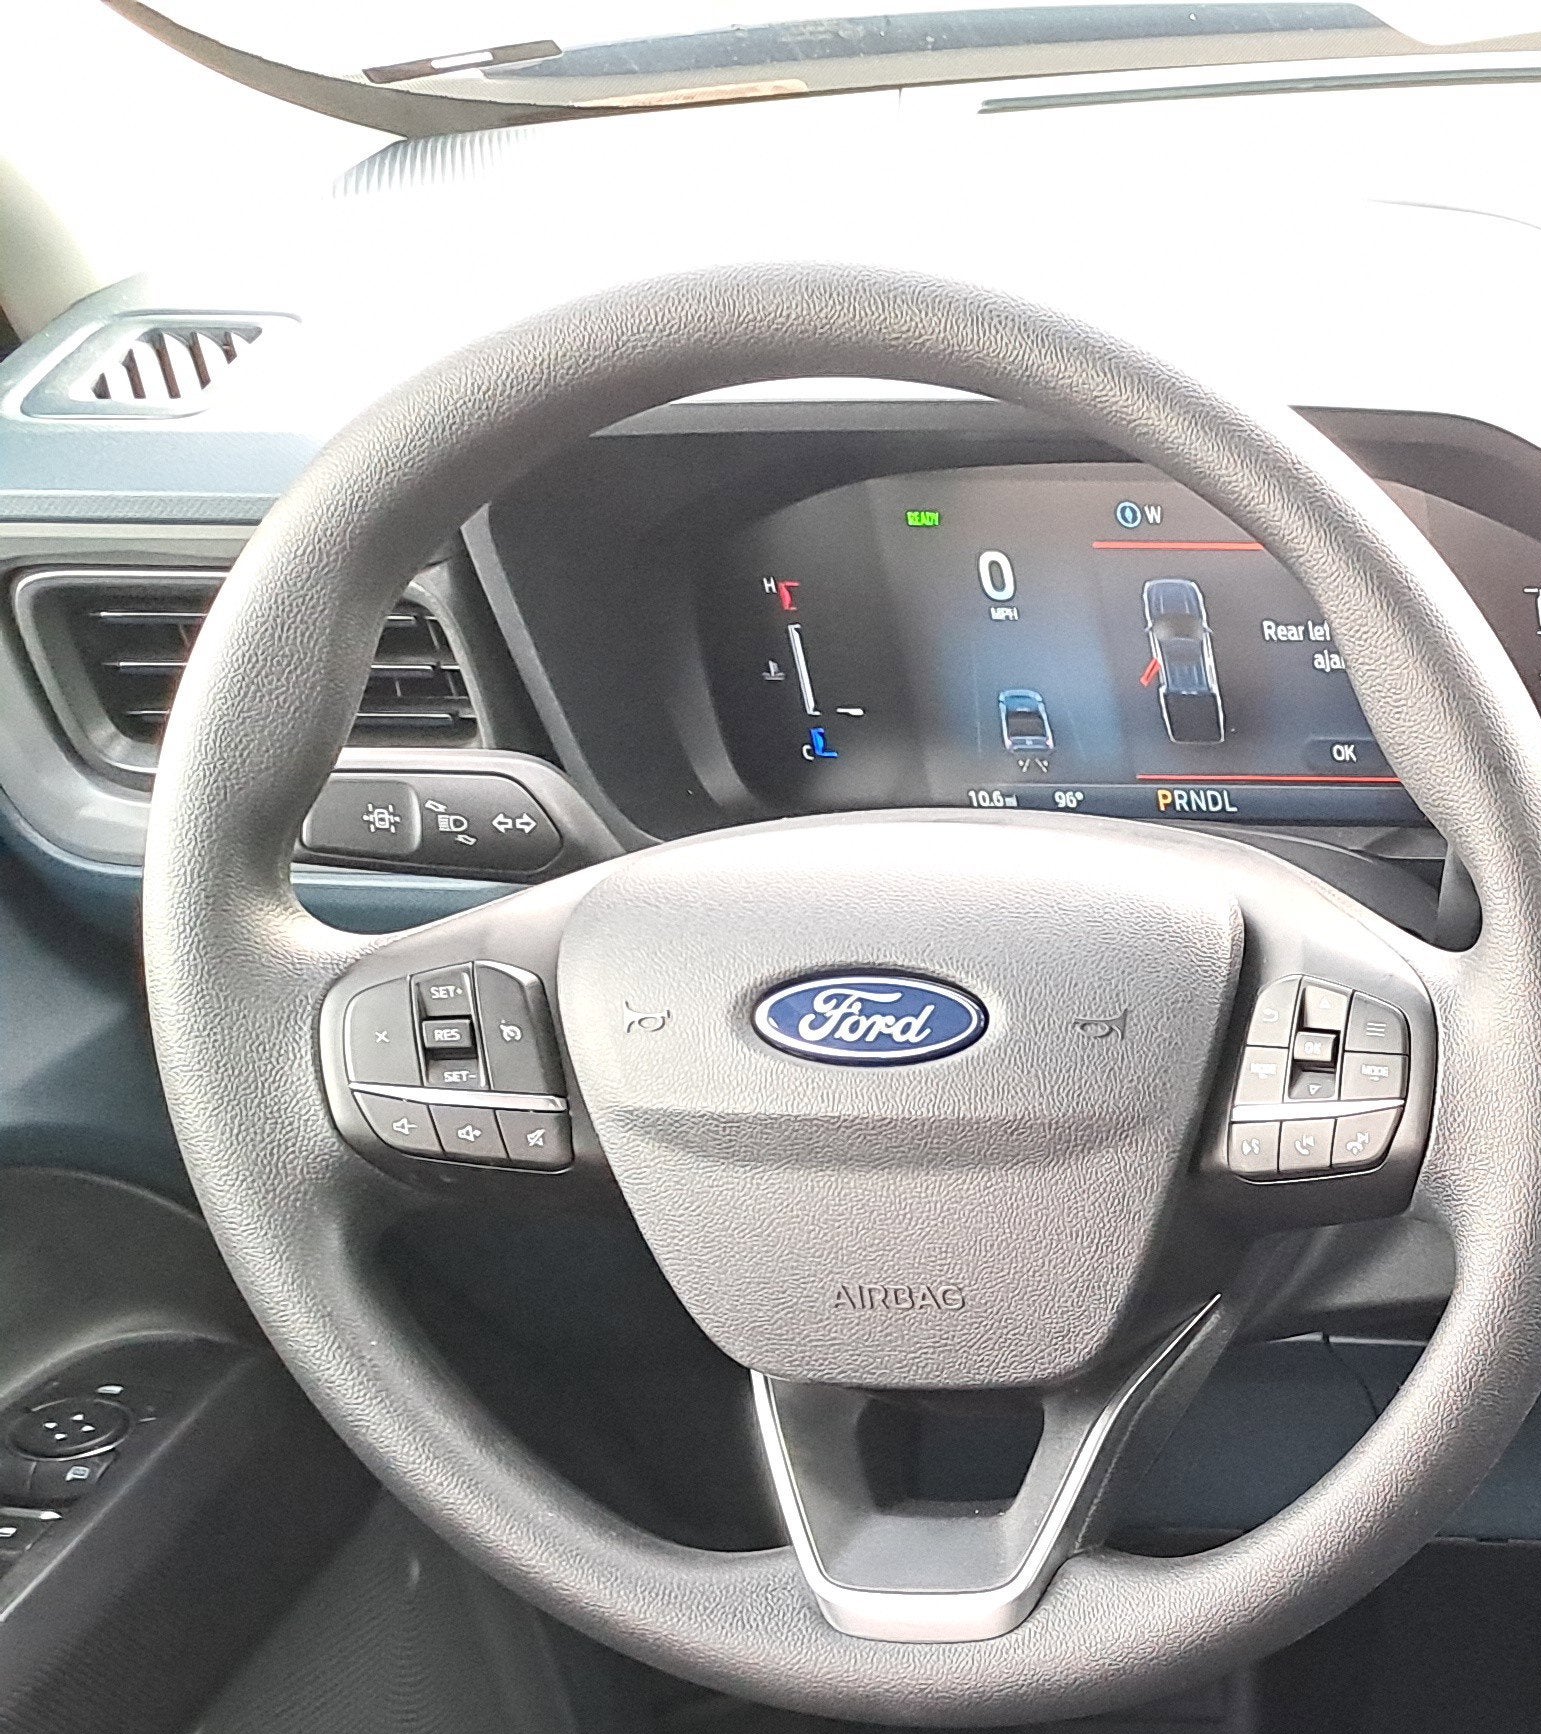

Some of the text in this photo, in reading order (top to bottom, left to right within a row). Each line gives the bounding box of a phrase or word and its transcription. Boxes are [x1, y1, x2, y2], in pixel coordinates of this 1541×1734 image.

[1145, 505, 1161, 524] W
[763, 577, 777, 593] H
[979, 550, 1016, 601] 0
[1262, 620, 1305, 641] Rear
[802, 744, 814, 761] C
[1331, 744, 1357, 763] OK
[798, 987, 935, 1044] Ford
[434, 1028, 461, 1042] RES
[833, 1284, 966, 1310] AIRBAG
